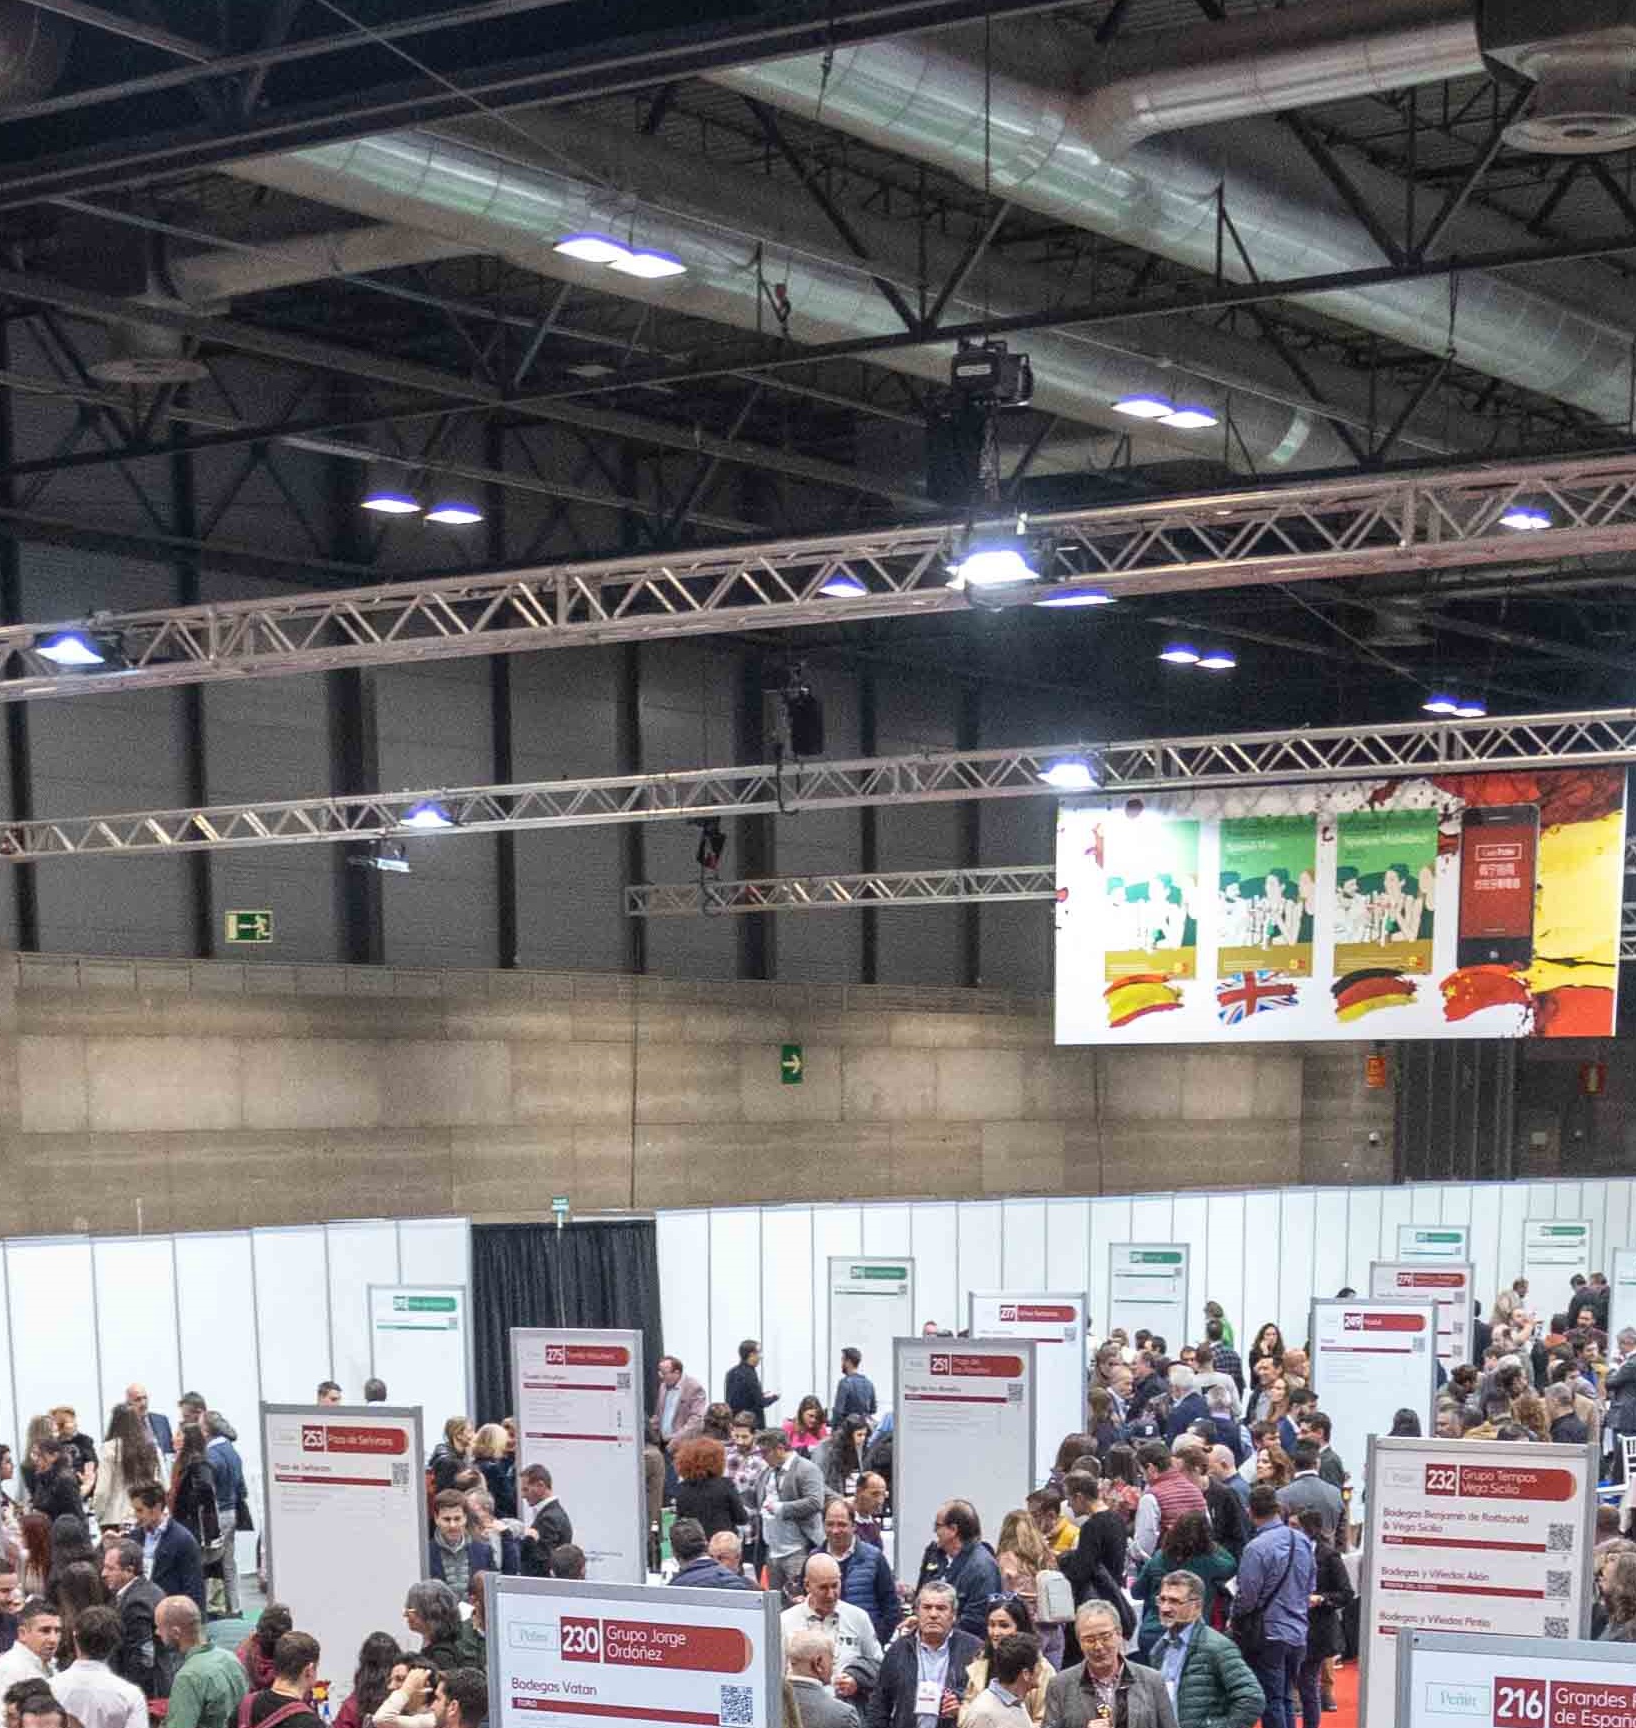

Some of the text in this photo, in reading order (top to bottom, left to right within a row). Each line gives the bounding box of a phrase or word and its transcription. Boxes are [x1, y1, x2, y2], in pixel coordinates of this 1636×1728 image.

[303, 1430, 324, 1447] 253
[1427, 1469, 1538, 1491] 232 Grupo Tempos
[1462, 1481, 1488, 1495] Vega
[562, 1624, 686, 1653] 230 Grupo Jorge
[606, 1644, 663, 1661] Ordóñez
[512, 1678, 598, 1696] Bodegas Vatan
[1497, 1686, 1543, 1721] 216
[1555, 1687, 1627, 1709] Grandes
[1554, 1708, 1577, 1725] de
